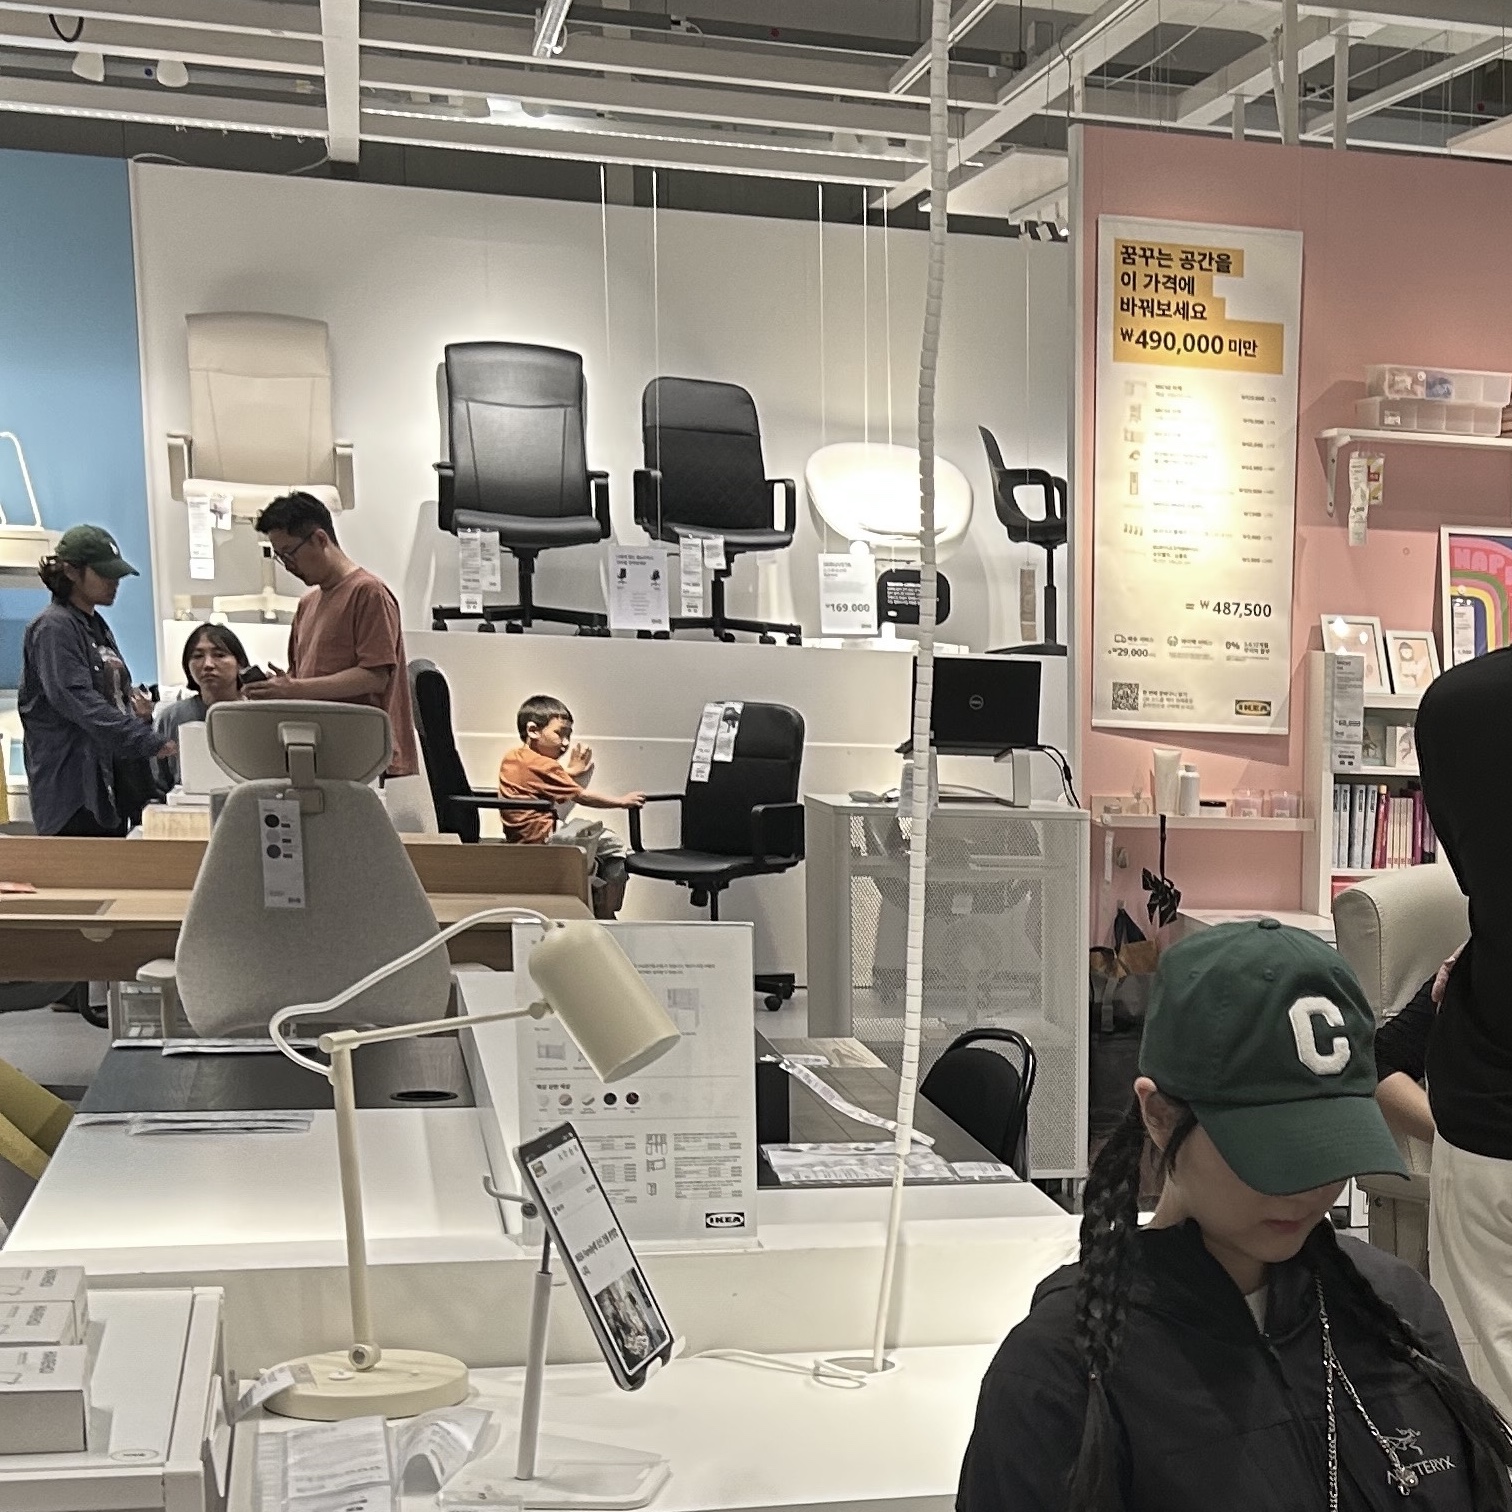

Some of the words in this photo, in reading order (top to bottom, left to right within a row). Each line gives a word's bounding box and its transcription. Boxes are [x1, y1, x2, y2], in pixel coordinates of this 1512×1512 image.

[1120, 245, 1173, 268] 꿈꾸는
[1179, 250, 1232, 273] 공간을
[1120, 271, 1136, 291] 이
[1144, 273, 1195, 296] 가격에
[1120, 297, 1207, 321] 바꿔보세요
[1228, 339, 1258, 358] 미만
[1288, 996, 1351, 1076] C
